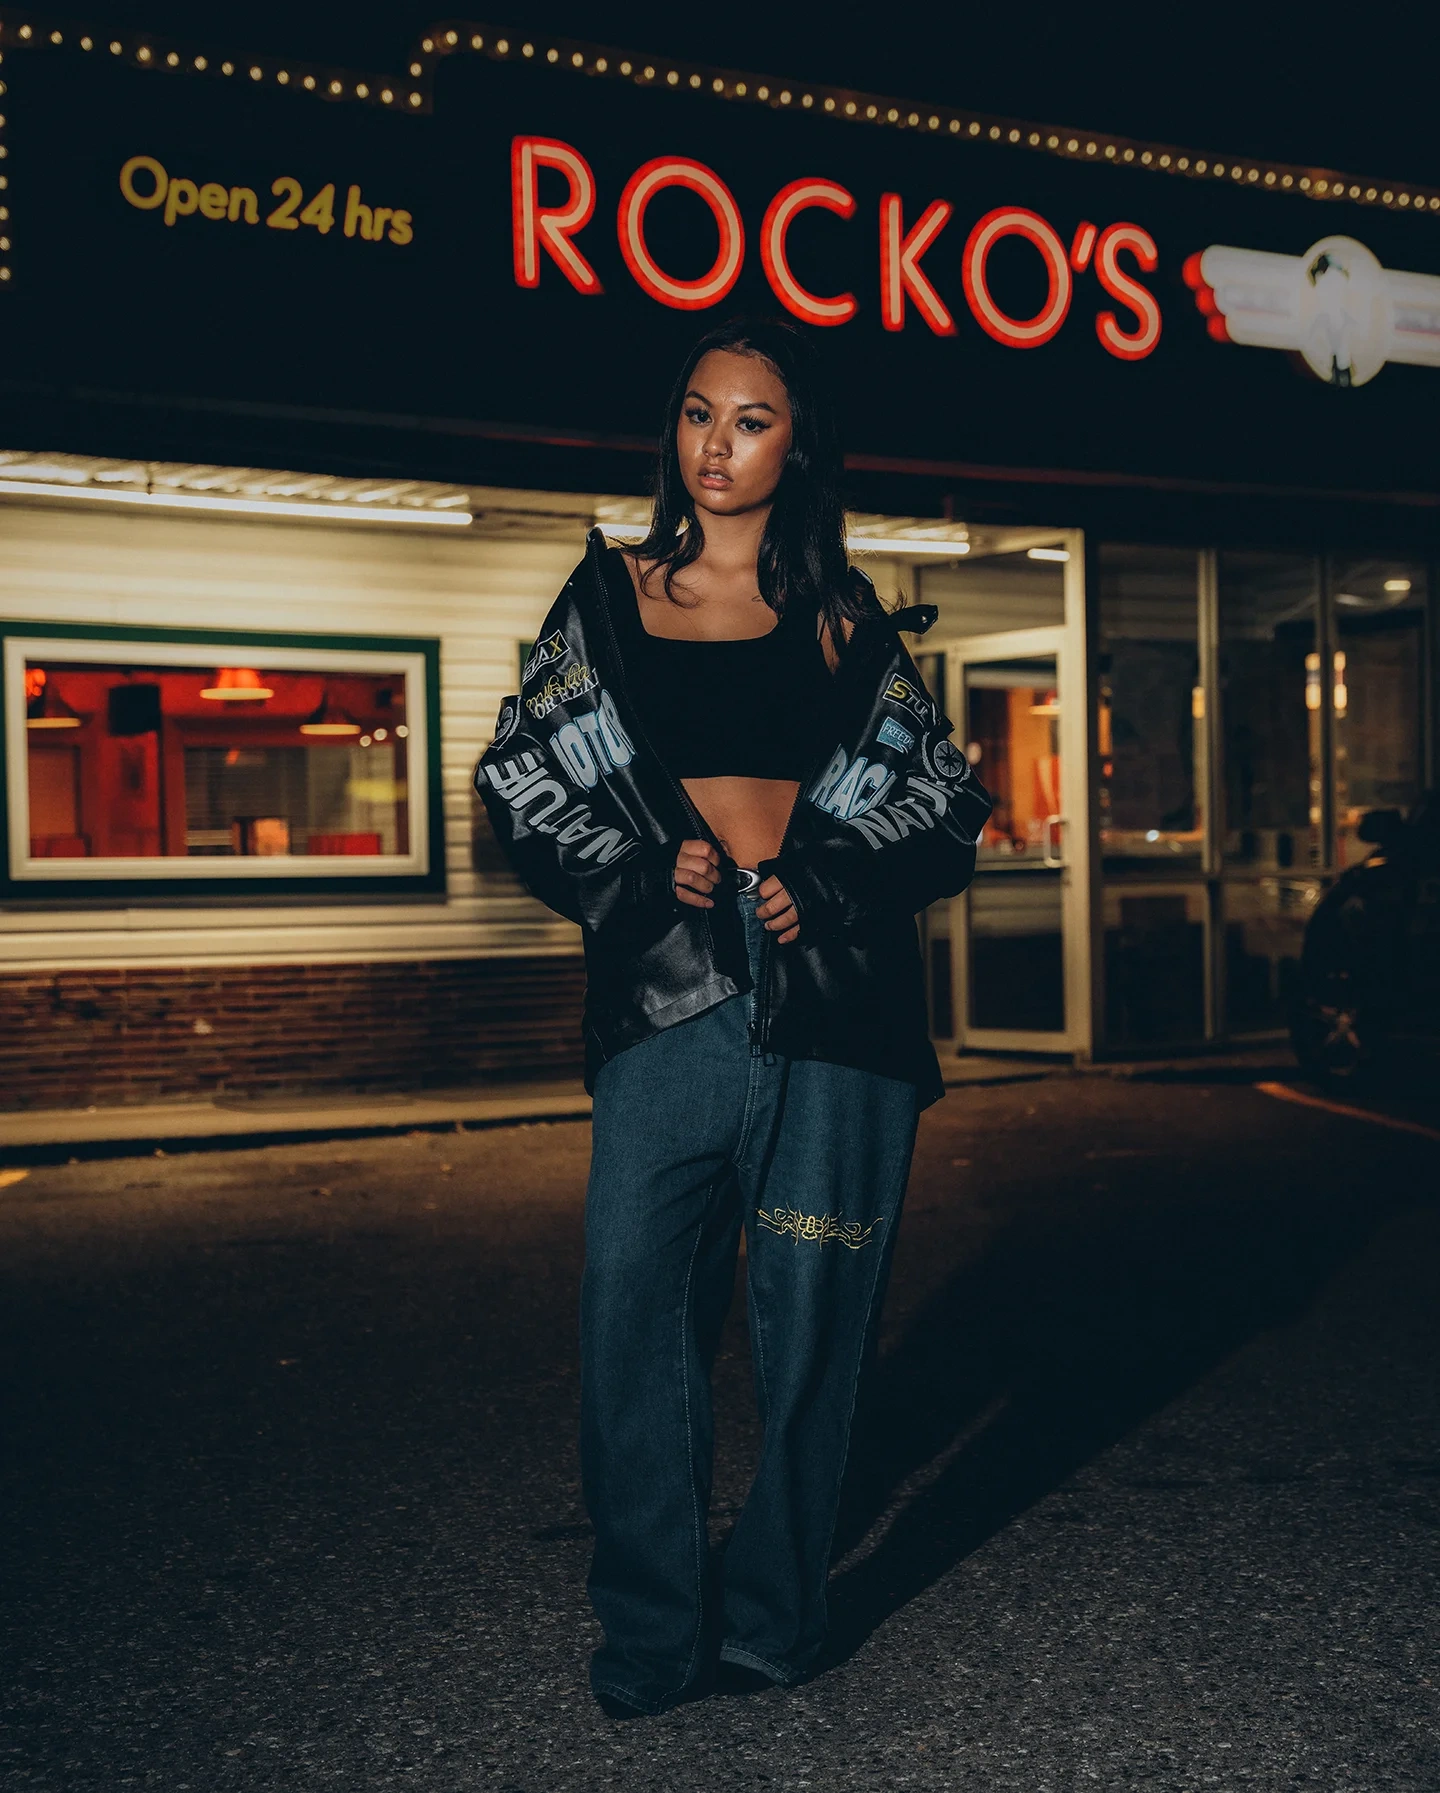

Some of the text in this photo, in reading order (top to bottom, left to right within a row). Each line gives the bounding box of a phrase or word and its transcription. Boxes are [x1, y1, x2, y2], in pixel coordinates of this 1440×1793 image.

[119, 155, 414, 245] Open 24 hrs
[511, 135, 1162, 361] ROCKO'S
